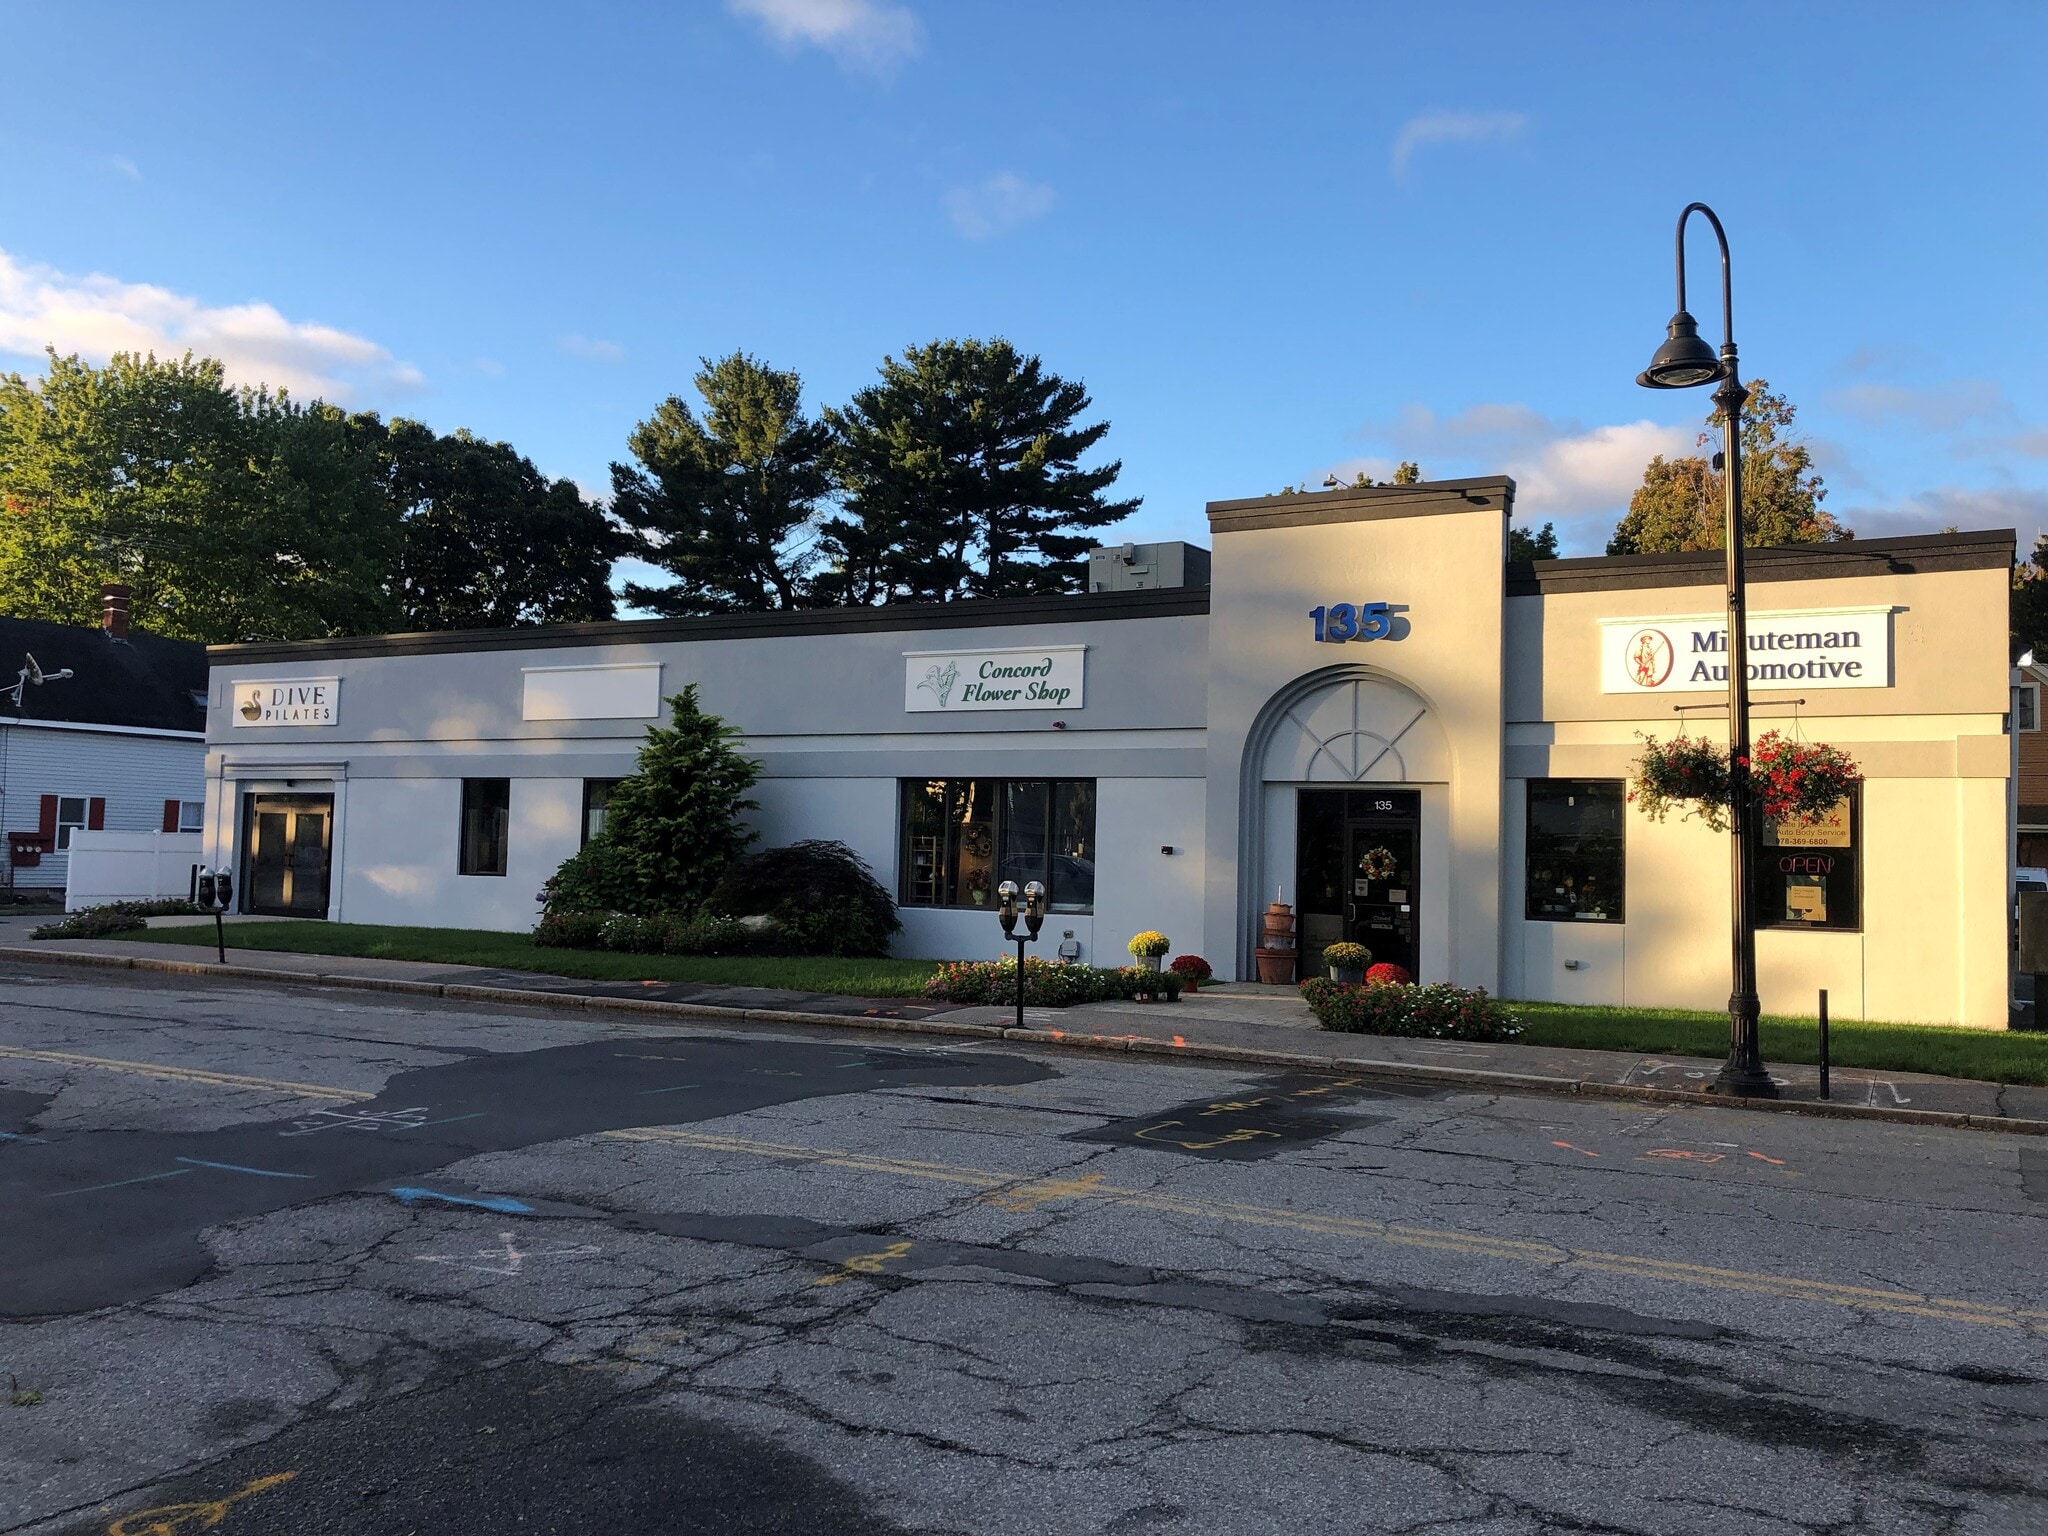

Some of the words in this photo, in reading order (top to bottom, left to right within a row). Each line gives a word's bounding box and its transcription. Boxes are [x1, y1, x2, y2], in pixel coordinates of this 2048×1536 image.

[1308, 602, 1391, 642] 135
[1690, 629, 1863, 653] Miuteman
[978, 657, 1053, 679] Concord
[1689, 656, 1863, 682] Auomotive
[271, 686, 326, 706] DIVE
[960, 682, 1022, 702] Flower
[1024, 680, 1071, 705] Shop
[265, 708, 330, 721] PILATES
[1374, 800, 1393, 811] 135
[1795, 829, 1816, 838] Body
[1779, 856, 1831, 873] OPEN
